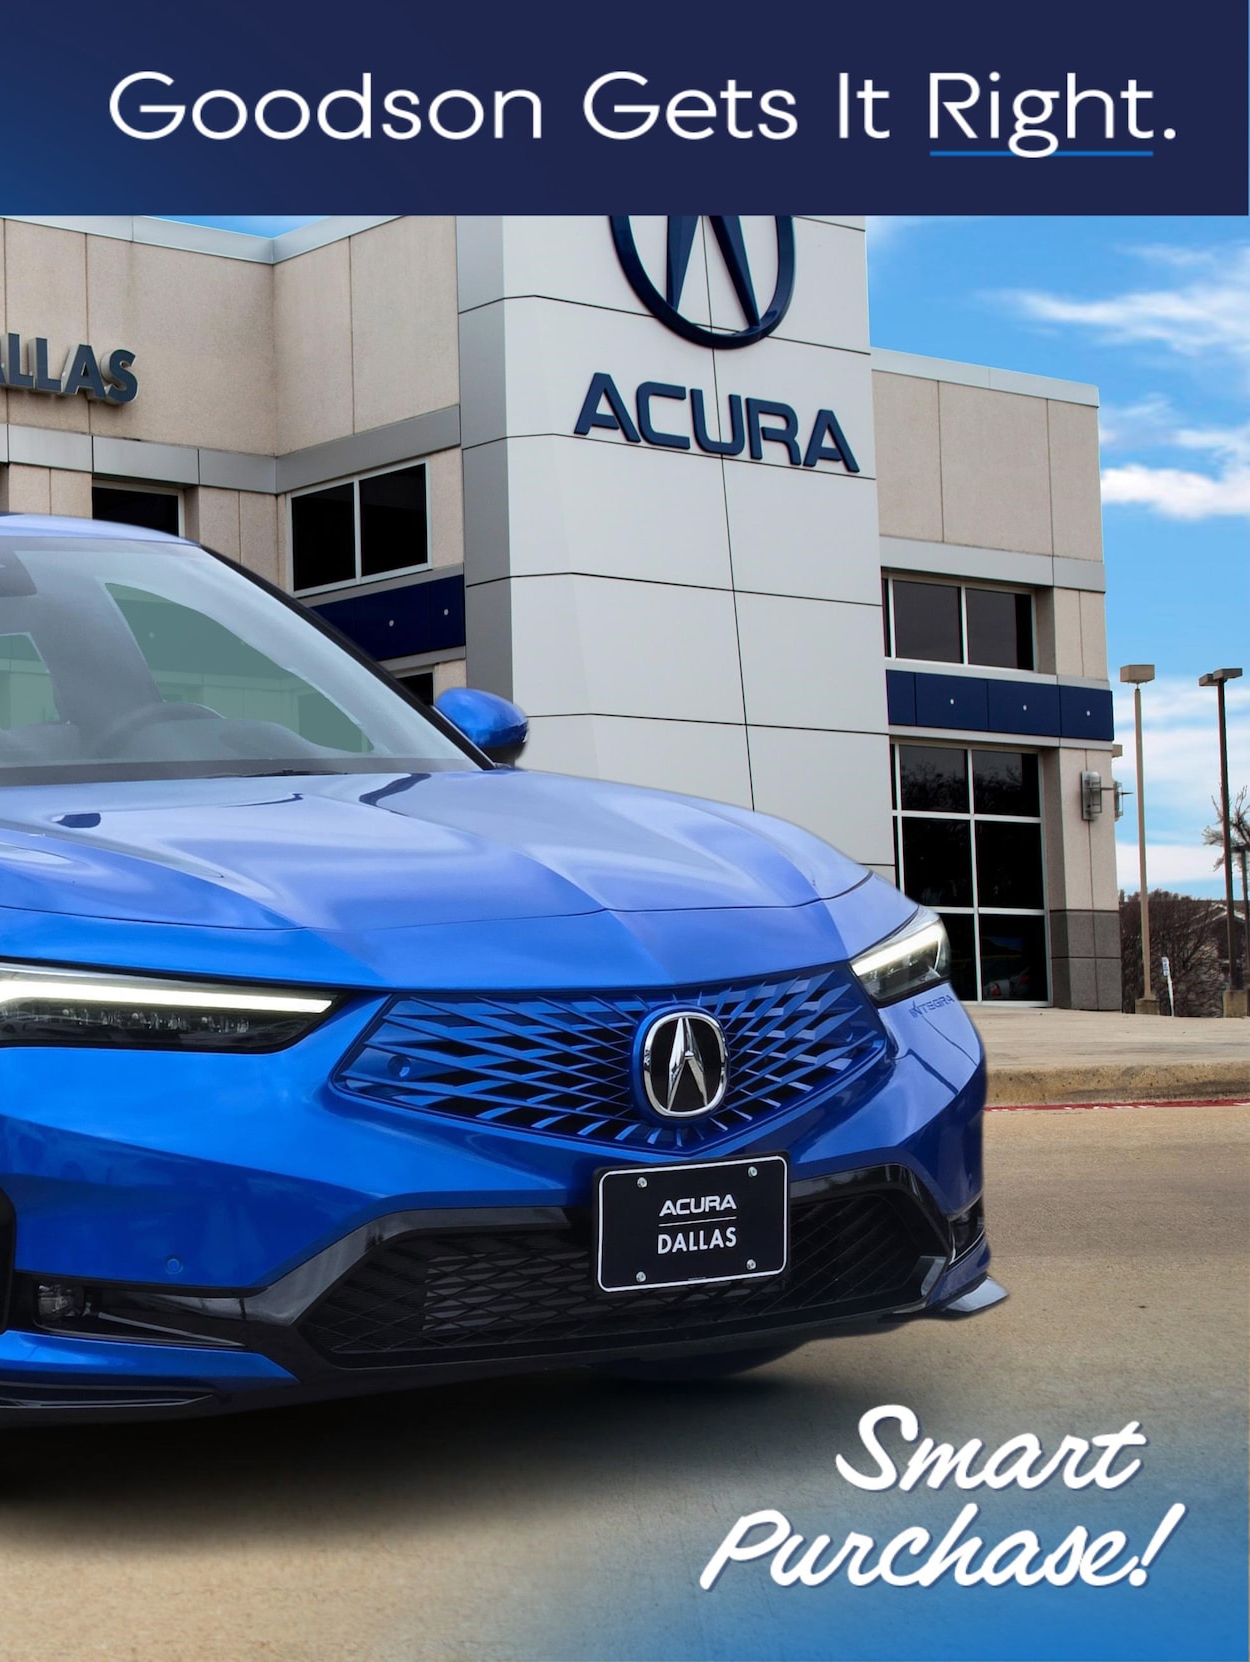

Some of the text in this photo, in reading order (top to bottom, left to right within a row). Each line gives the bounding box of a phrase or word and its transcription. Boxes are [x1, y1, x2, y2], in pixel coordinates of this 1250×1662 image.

[574, 372, 860, 473] ACURA
[909, 995, 955, 1018] INTEGRA
[658, 1194, 737, 1217] ACURA
[657, 1227, 737, 1254] DALLAS
